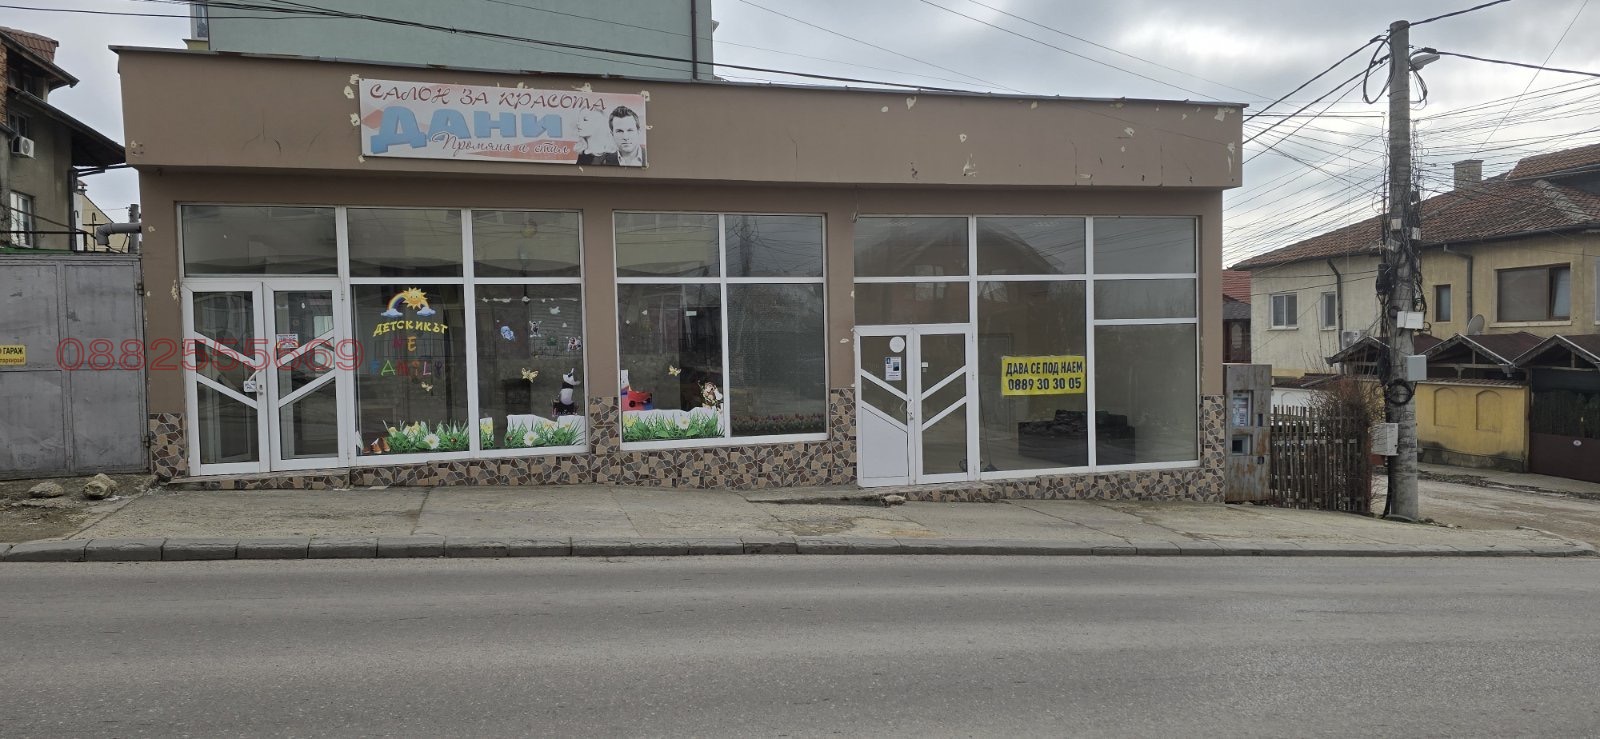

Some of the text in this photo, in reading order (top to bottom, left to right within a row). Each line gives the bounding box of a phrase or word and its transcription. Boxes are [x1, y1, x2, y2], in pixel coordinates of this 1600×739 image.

[370, 83, 607, 111] САЛОН ЗА КРАСОТА
[370, 105, 563, 154] ДАНИ
[431, 131, 570, 157] Промяна и стил
[1006, 361, 1083, 376] ДАВА СЕ ПОД НАЕМ
[1008, 377, 1082, 391] 0889 30 30 05
